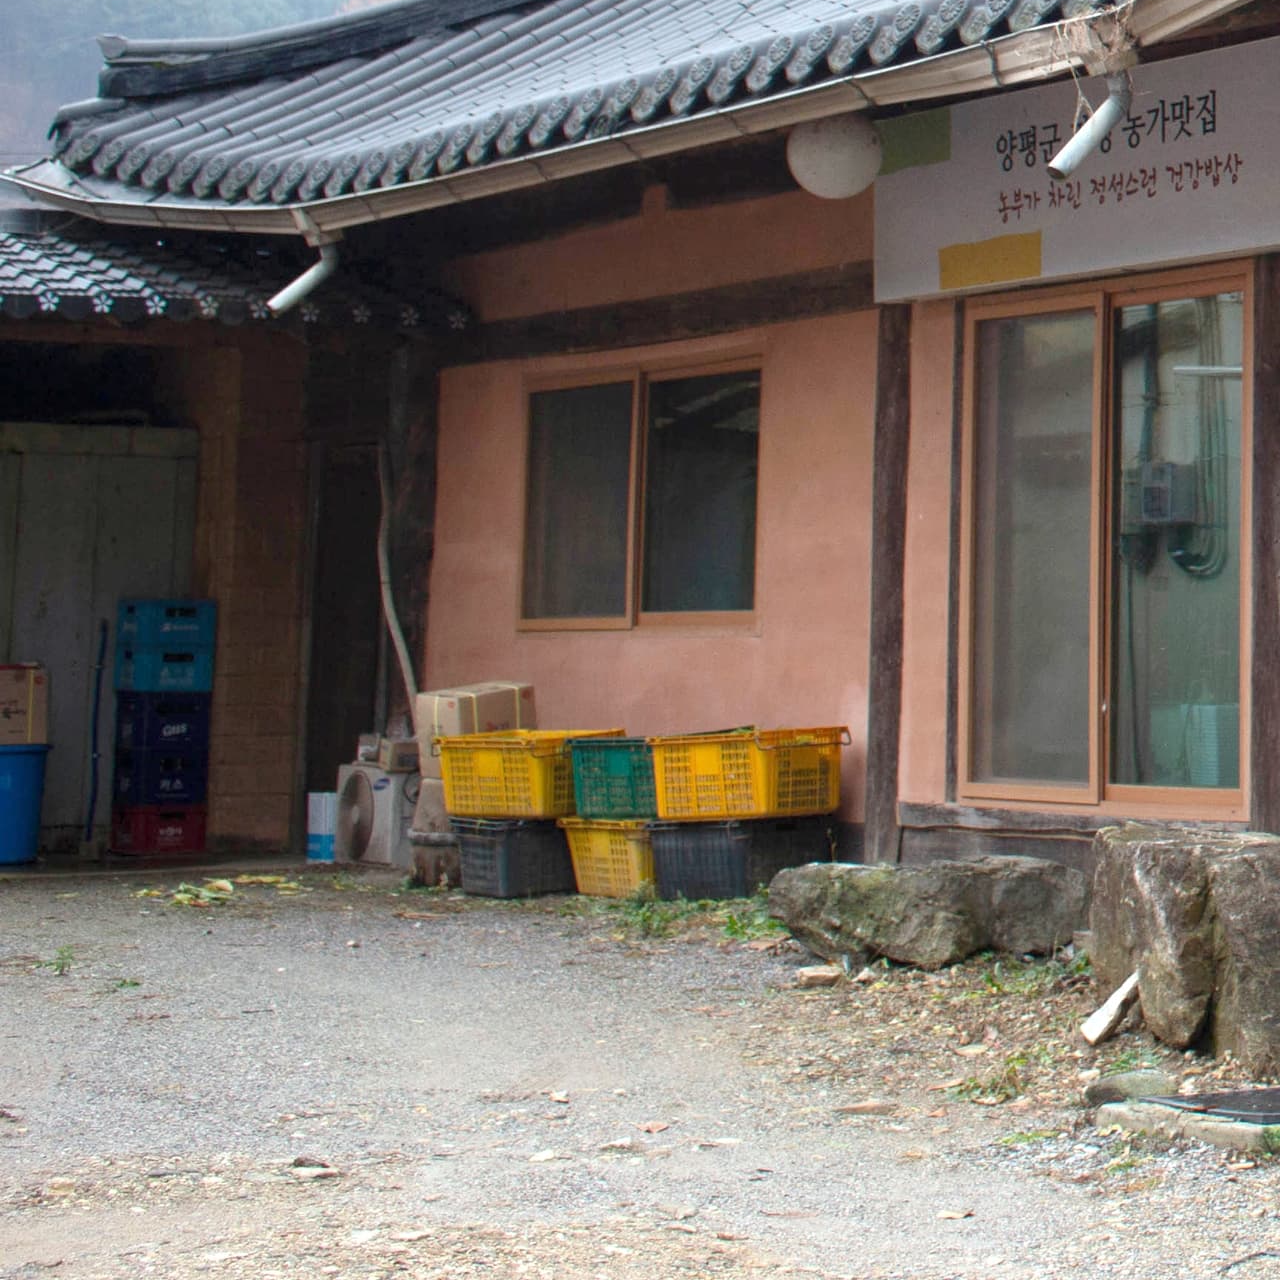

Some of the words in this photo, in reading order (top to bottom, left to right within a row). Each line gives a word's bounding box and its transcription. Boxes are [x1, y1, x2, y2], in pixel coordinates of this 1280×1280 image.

[995, 122, 1062, 172] 양평군
[1122, 89, 1218, 149] 농가맛집
[998, 188, 1041, 224] 농부가
[1049, 178, 1082, 209] 차린
[1089, 167, 1158, 204] 정성스런
[1166, 152, 1243, 193] 건강밥상
